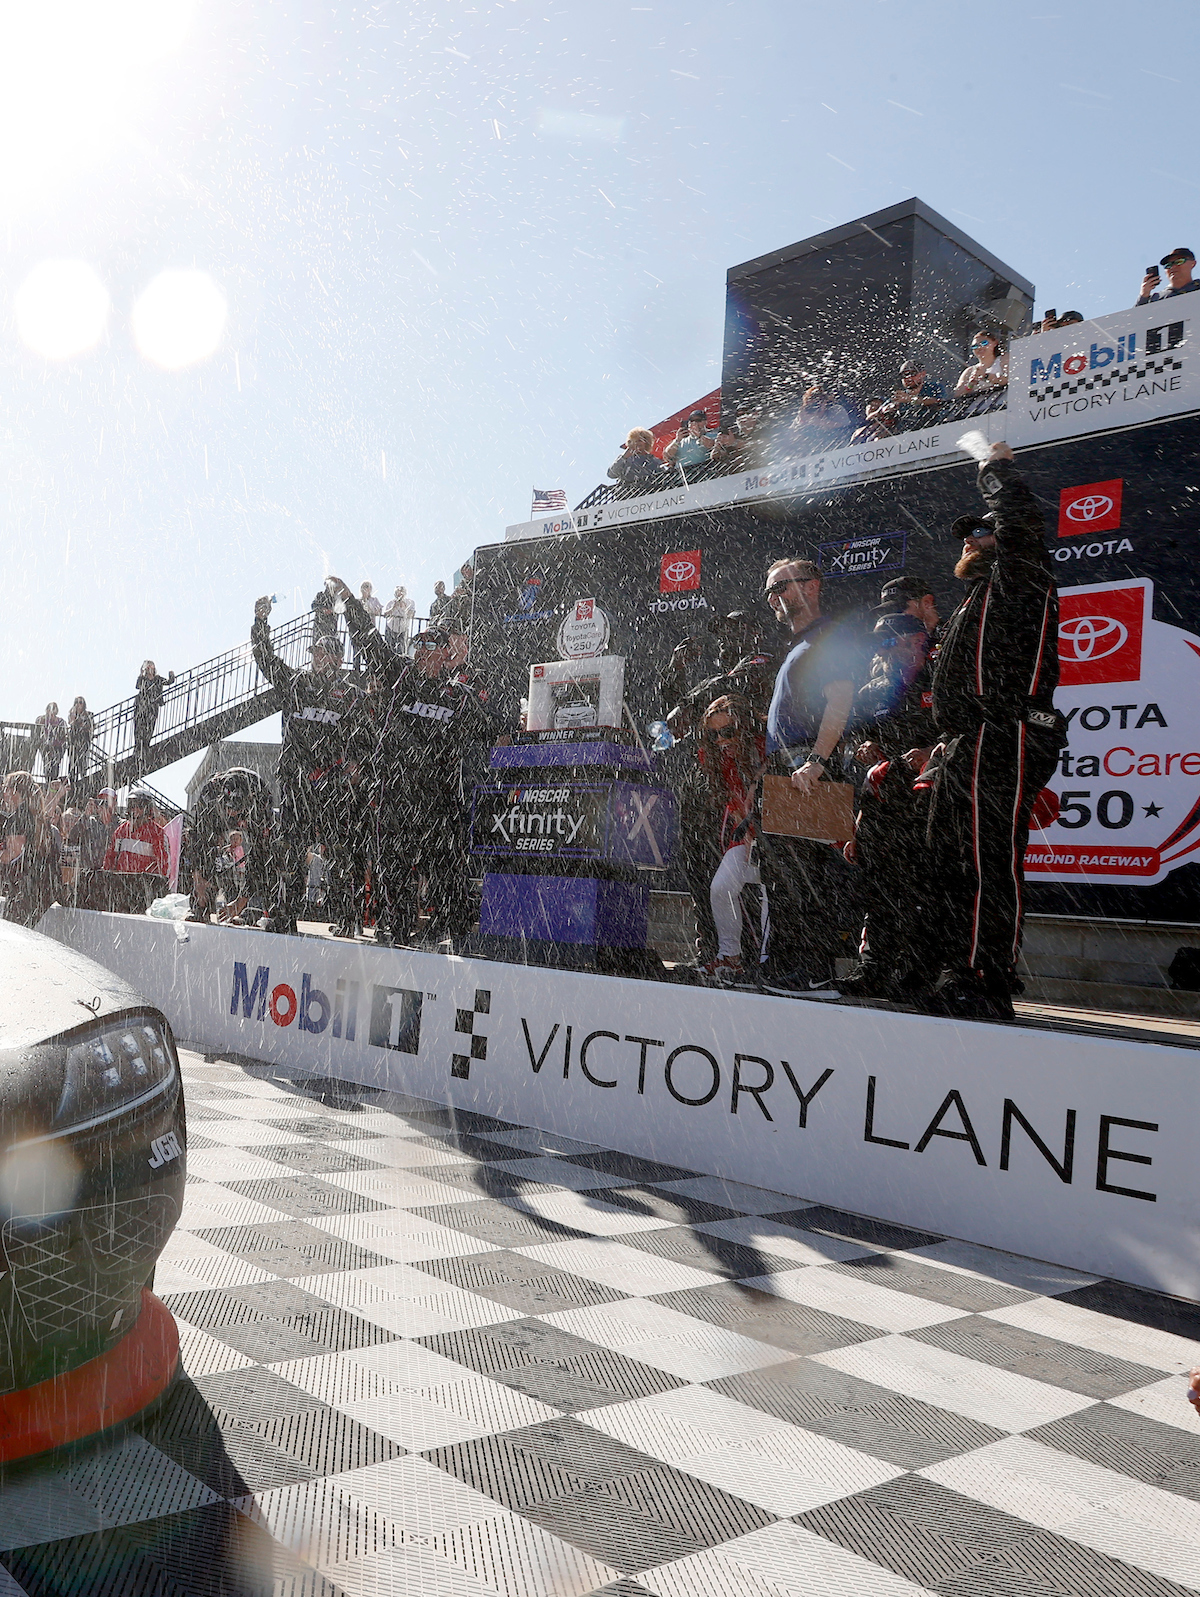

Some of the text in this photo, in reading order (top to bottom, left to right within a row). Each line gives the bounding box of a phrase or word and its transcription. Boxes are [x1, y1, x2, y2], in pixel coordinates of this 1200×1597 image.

[1030, 333, 1136, 385] Mobil
[1029, 375, 1182, 422] VICTORY LANE
[831, 445, 895, 470] VICTORY
[898, 435, 941, 455] LANE
[543, 518, 576, 535] Mobil
[607, 501, 653, 520] VICTORY
[656, 493, 686, 510] LANE
[850, 537, 881, 549] NASCAR
[1048, 538, 1134, 562] OYOTA
[831, 547, 891, 570] xfinity
[847, 562, 873, 572] SERIES
[650, 597, 708, 614] TOYOTA
[571, 622, 596, 631] TOYOTA
[293, 706, 342, 726] JGR
[402, 701, 455, 724] JGR
[1056, 703, 1168, 732] YOTA
[539, 730, 573, 741] WINNER
[1058, 746, 1200, 778] taCare
[522, 789, 571, 803] NASCAR
[1055, 789, 1135, 830] 50
[490, 805, 586, 845] xfinity
[515, 838, 554, 851] SERIES
[1023, 854, 1153, 867] HMOND RACEWAY
[230, 961, 360, 1042] Mobil
[521, 1017, 835, 1128] VICTORY
[864, 1075, 1159, 1202] LANE
[147, 1131, 183, 1169] JGR
